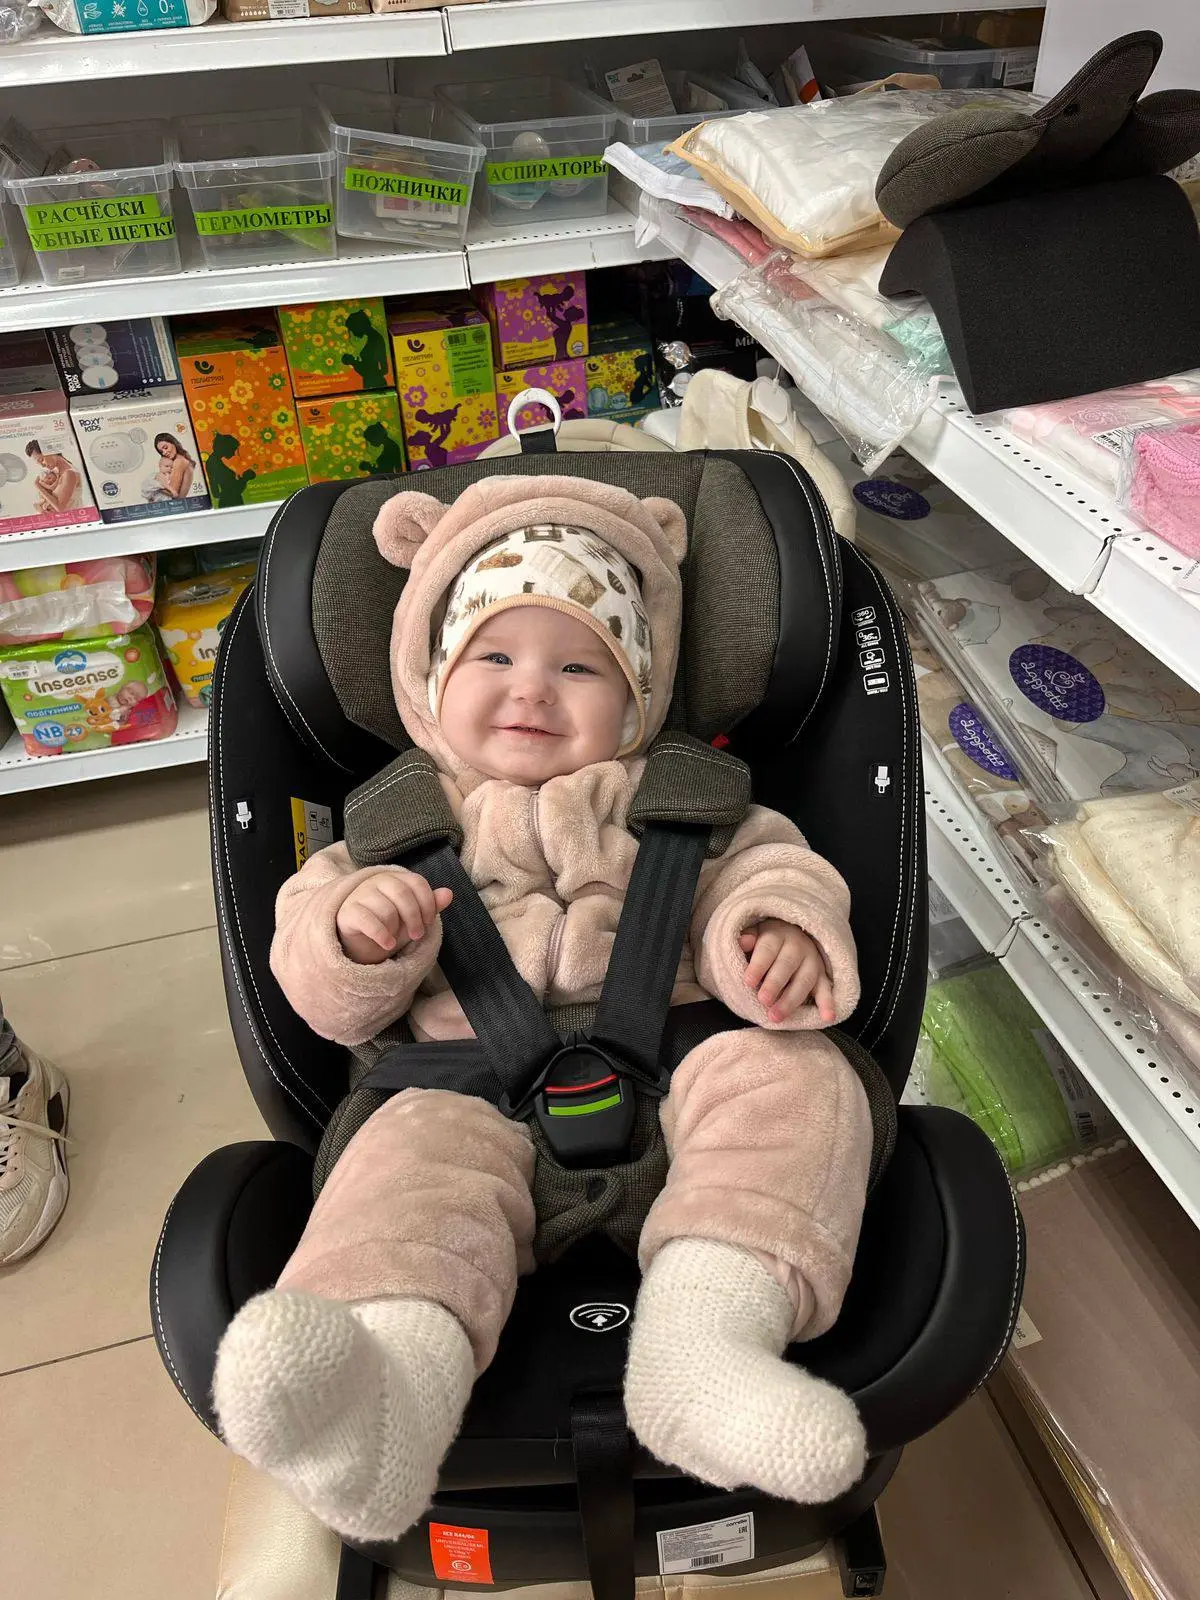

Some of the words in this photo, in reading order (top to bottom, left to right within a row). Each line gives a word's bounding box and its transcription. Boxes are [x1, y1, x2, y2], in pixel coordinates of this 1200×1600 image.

[490, 160, 607, 182] АСПИРАТОРЫ
[352, 173, 462, 203] НОЖНИЧКИ
[36, 200, 146, 225] РАСЧЁСКИ
[196, 208, 332, 232] ТЕРМОМЕТРЫ
[31, 228, 103, 248] УБНЫЕ
[107, 220, 175, 241] ЩЕТКИ
[65, 373, 77, 392] ROXY
[79, 418, 101, 427] ROXY
[84, 424, 101, 433] KIDS
[192, 481, 203, 491] 36
[34, 668, 119, 693] Inseense
[34, 725, 63, 740] NB
